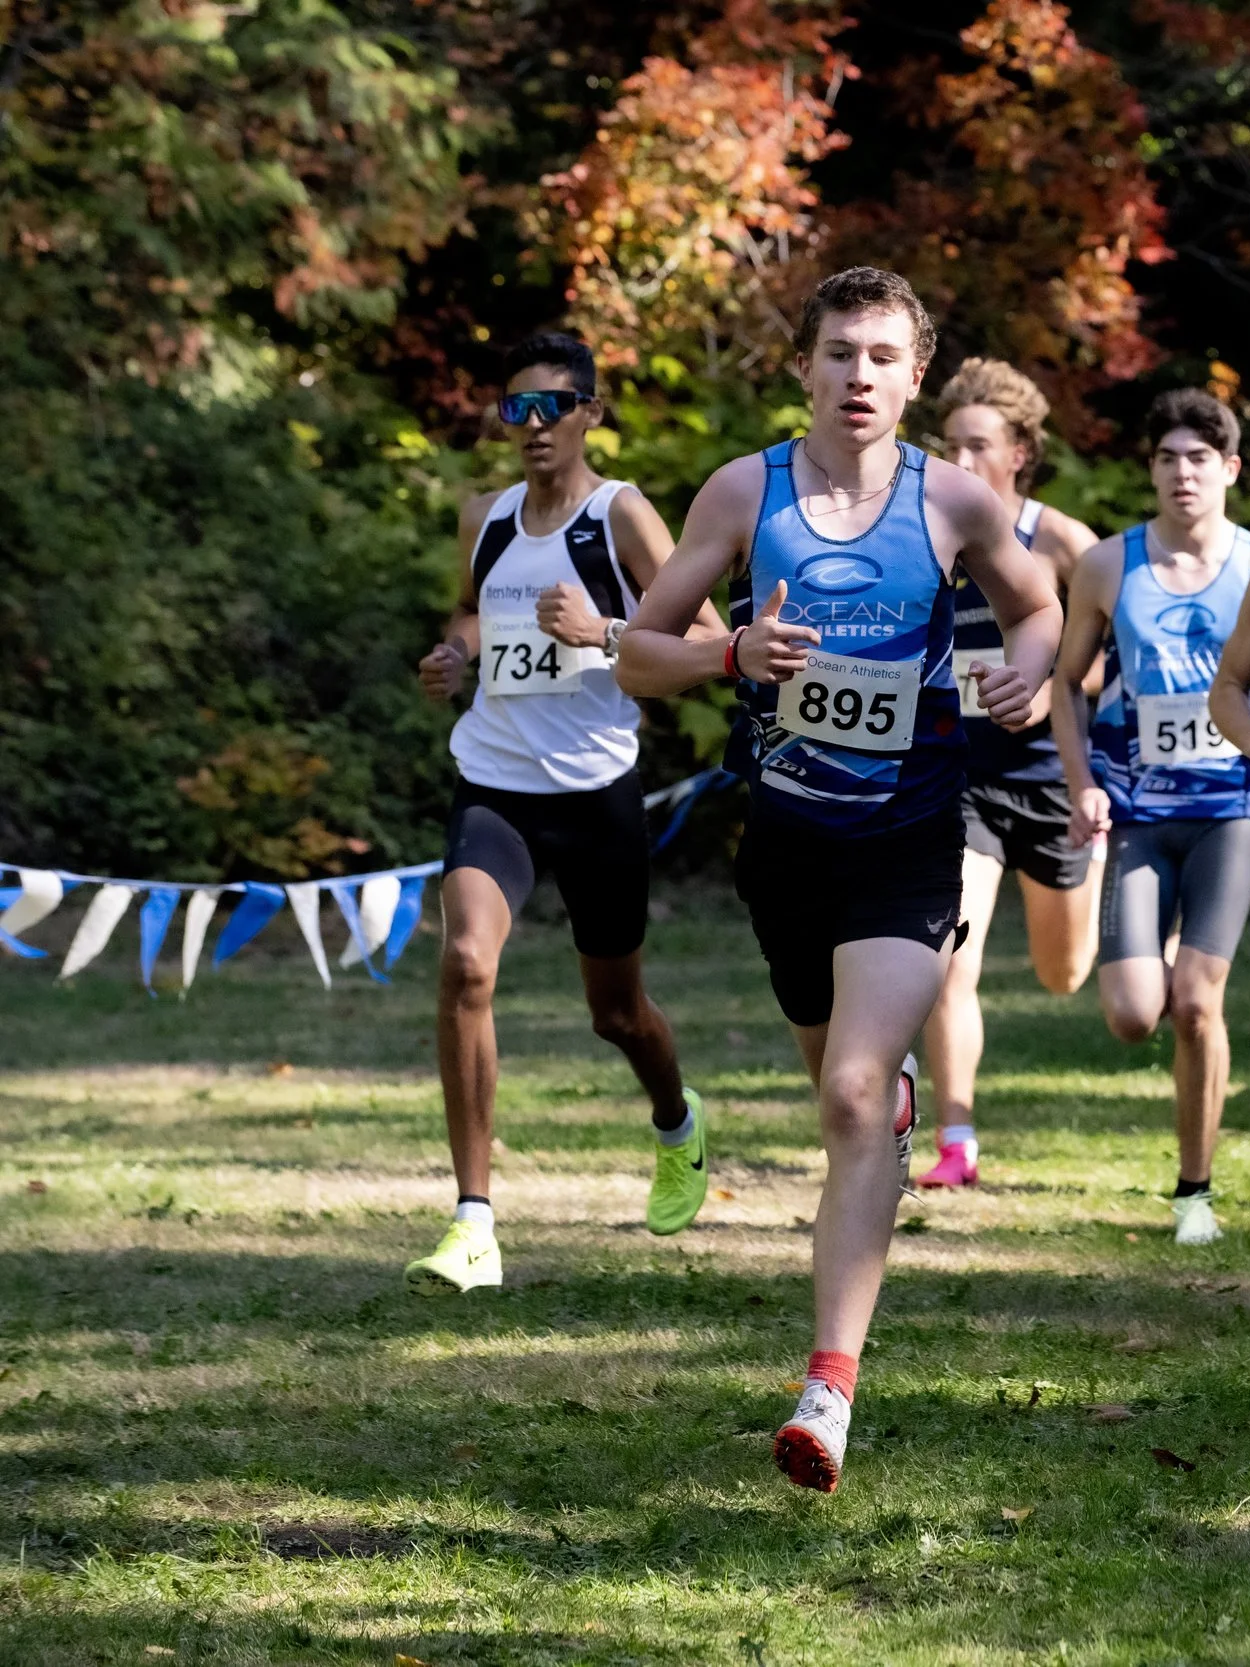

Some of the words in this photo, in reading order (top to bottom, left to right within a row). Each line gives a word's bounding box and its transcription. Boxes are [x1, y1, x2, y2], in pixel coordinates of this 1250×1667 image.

[486, 584, 522, 602] Hershey
[777, 601, 906, 622] OCEAN
[491, 642, 561, 682] 734
[808, 656, 847, 674] Ocean
[850, 664, 901, 680] Athletics
[799, 681, 898, 736] 895
[1157, 719, 1224, 753] 519
